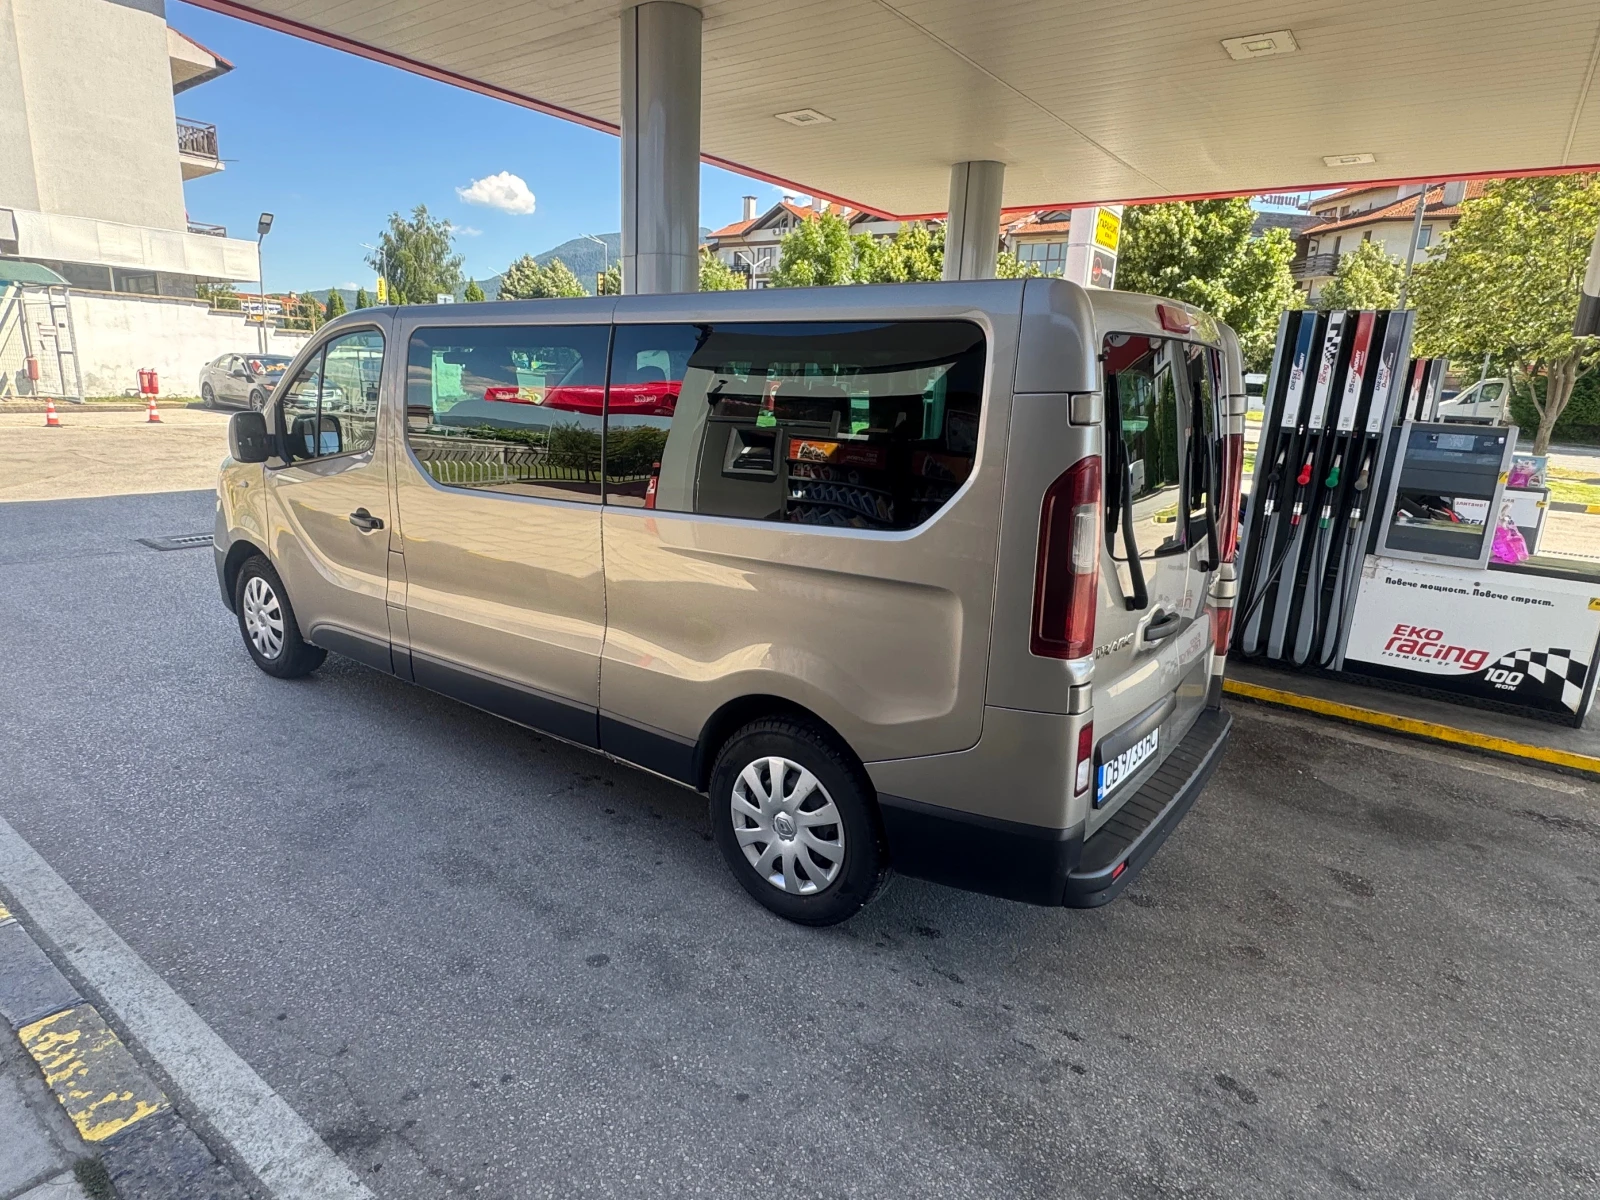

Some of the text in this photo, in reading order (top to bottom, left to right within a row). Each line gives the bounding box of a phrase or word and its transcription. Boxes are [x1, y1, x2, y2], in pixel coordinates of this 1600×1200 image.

[1385, 577, 1555, 607] Повече мощност. Повече страст.
[1392, 624, 1444, 641] EKO
[1381, 651, 1430, 664] FORMULA
[1384, 636, 1490, 671] racing
[1484, 667, 1524, 686] 100
[1494, 683, 1517, 691] RON
